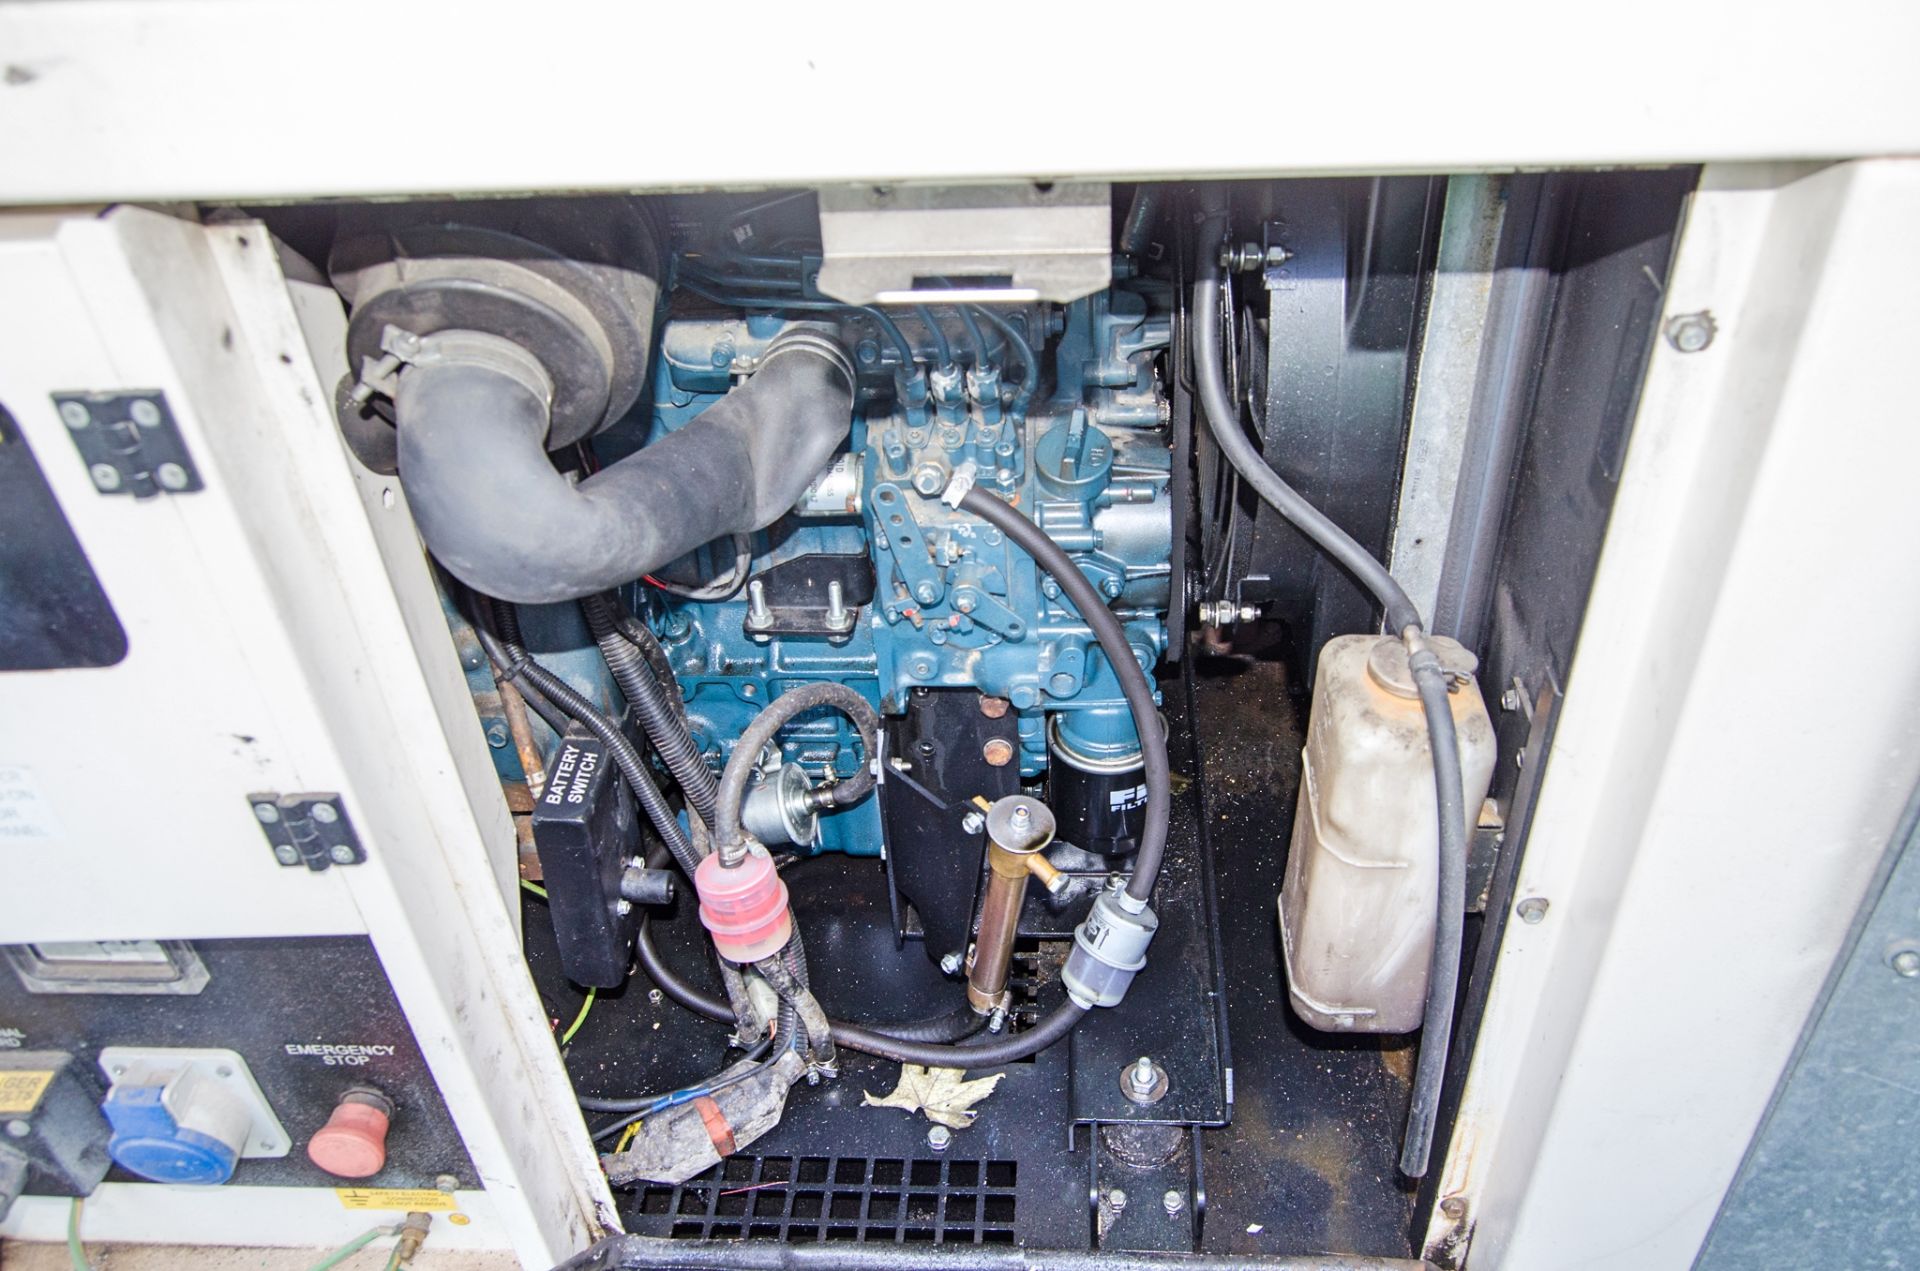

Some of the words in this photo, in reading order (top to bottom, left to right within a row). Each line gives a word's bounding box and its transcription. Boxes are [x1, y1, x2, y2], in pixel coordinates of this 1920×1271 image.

[545, 744, 580, 805] BATTERY
[567, 752, 599, 804] SWITCH
[285, 1044, 395, 1055] EMERGENCY
[322, 1055, 370, 1066] STOP
